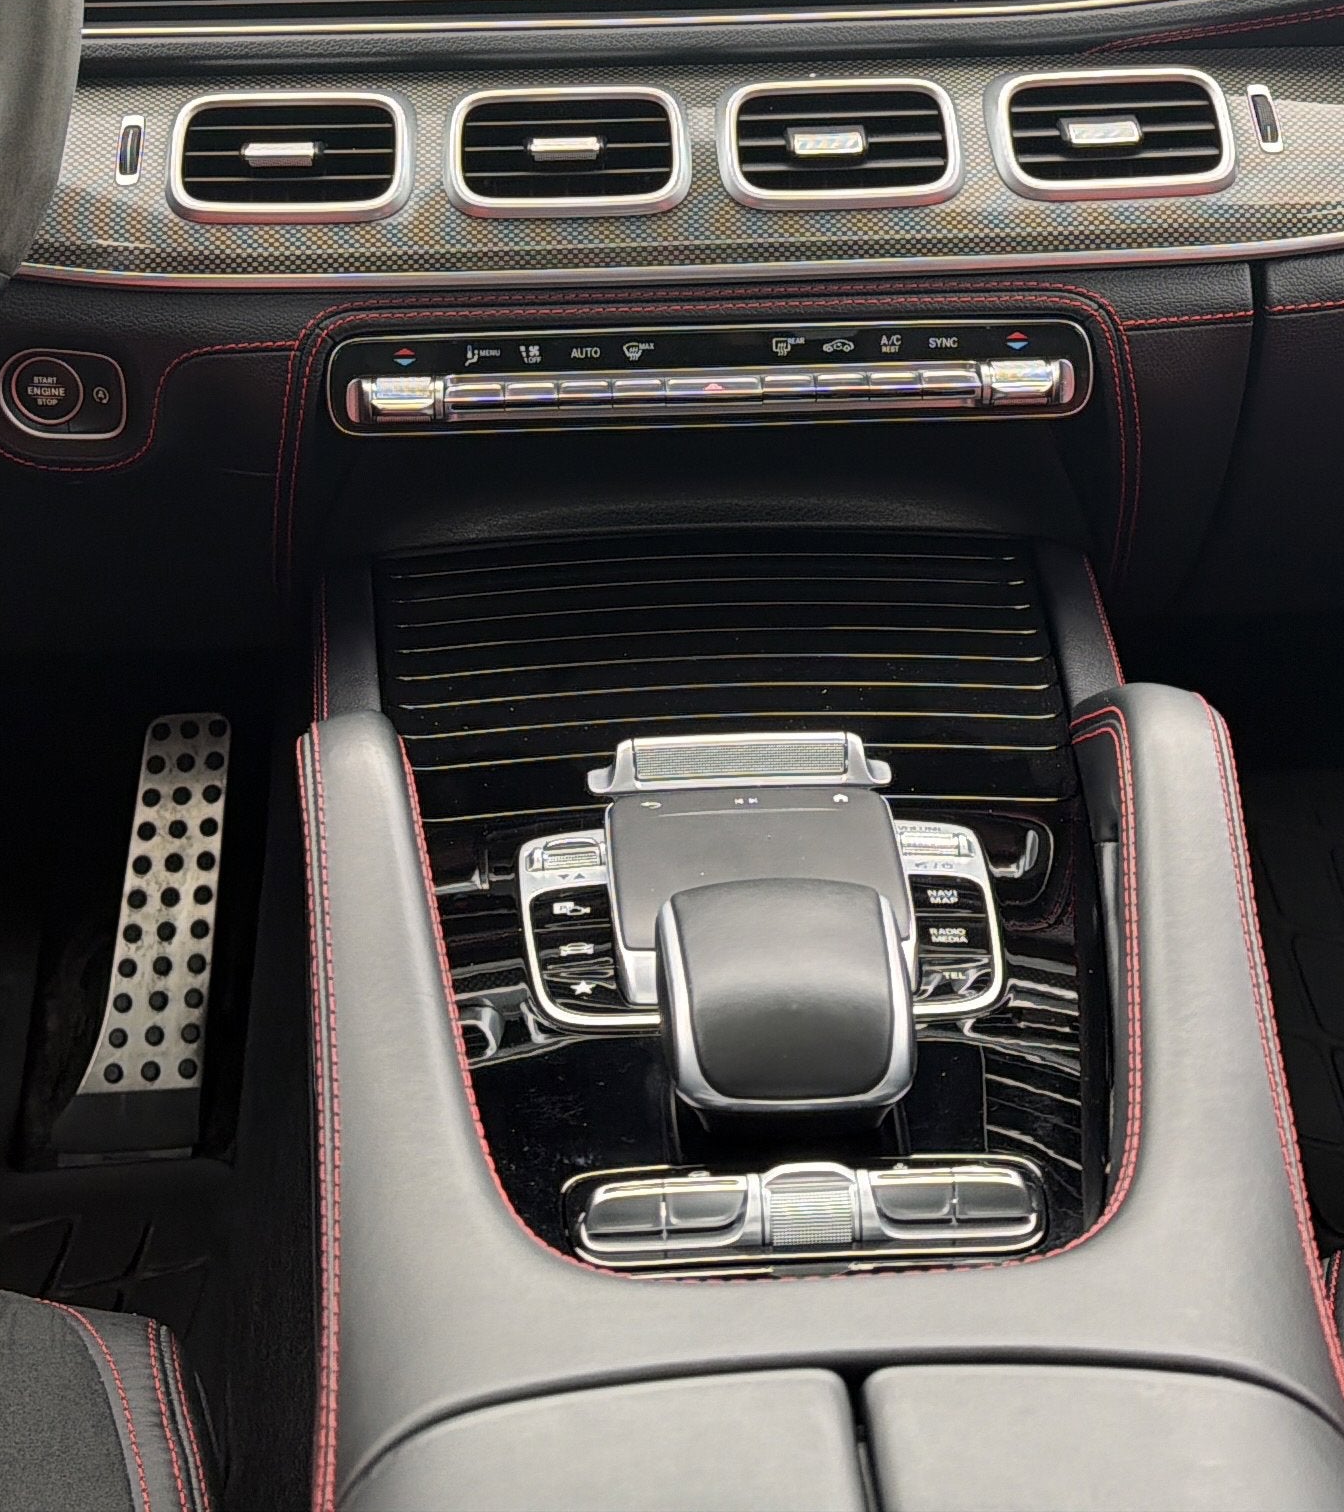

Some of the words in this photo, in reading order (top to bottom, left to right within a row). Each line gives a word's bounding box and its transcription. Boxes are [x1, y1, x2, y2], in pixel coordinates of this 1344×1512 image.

[880, 335, 901, 345] A/C
[928, 337, 958, 349] SYNC
[479, 349, 501, 357] MENU
[570, 347, 601, 359] AUTO
[527, 356, 542, 364] OFF
[33, 376, 57, 384] START
[27, 386, 66, 397] ENGINE
[37, 398, 58, 406] STOP
[927, 889, 958, 897] NAVI
[929, 927, 967, 936] RADIO
[931, 935, 968, 943] MEDIA
[942, 971, 967, 980] TEL
